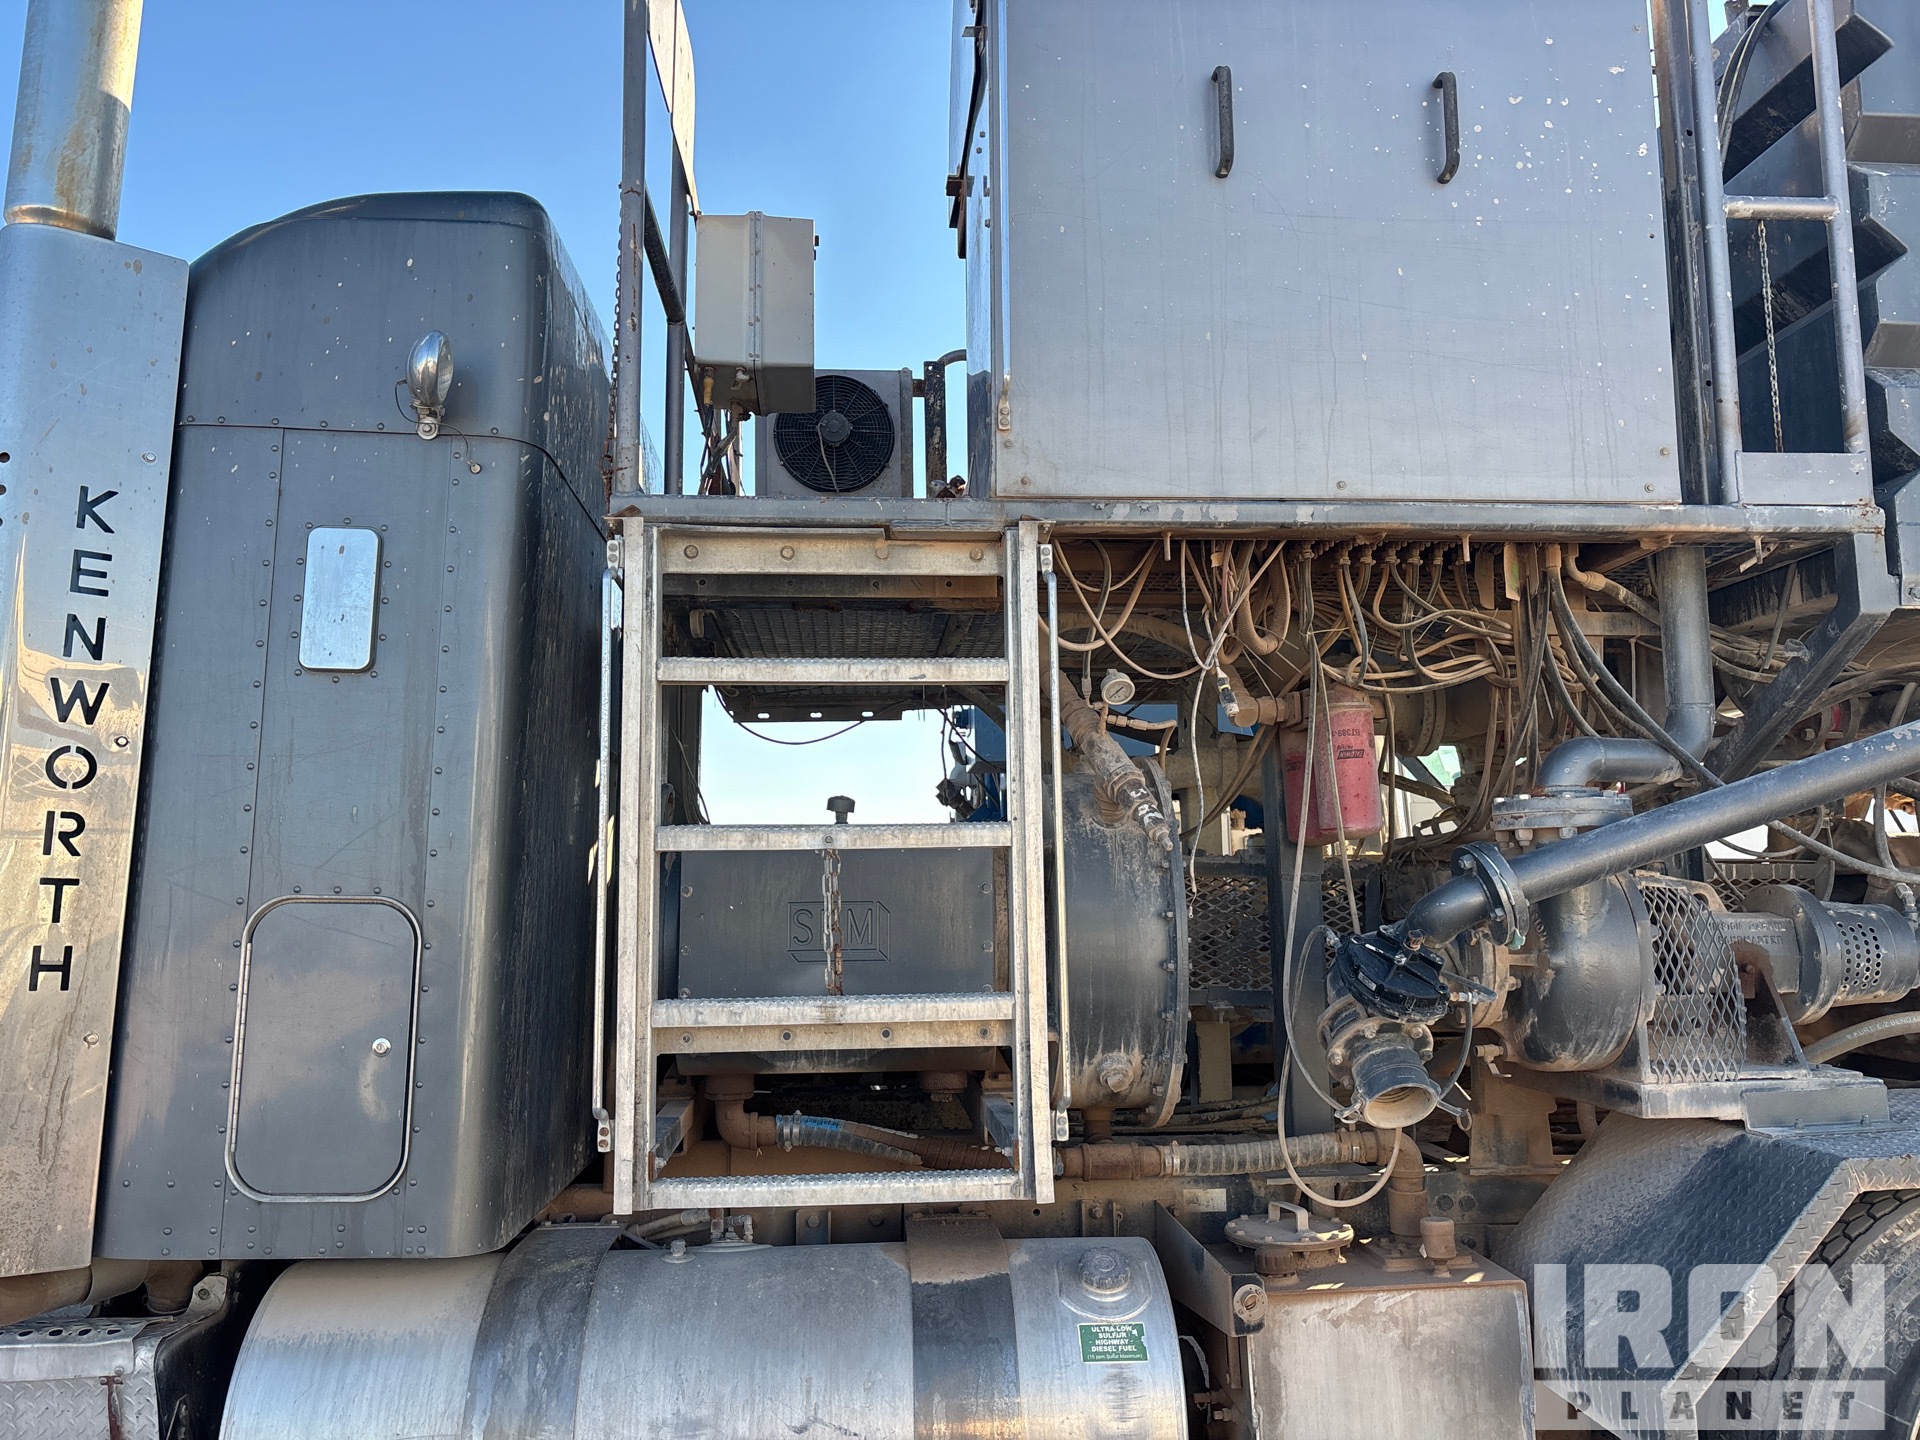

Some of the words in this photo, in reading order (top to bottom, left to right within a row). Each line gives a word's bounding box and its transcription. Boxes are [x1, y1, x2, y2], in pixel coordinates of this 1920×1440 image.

[29, 485, 118, 991] KENWORTH
[793, 908, 873, 946] SM
[1852, 1026, 1873, 1038] KURT
[1091, 1325, 1132, 1333] ULTRA-LOW
